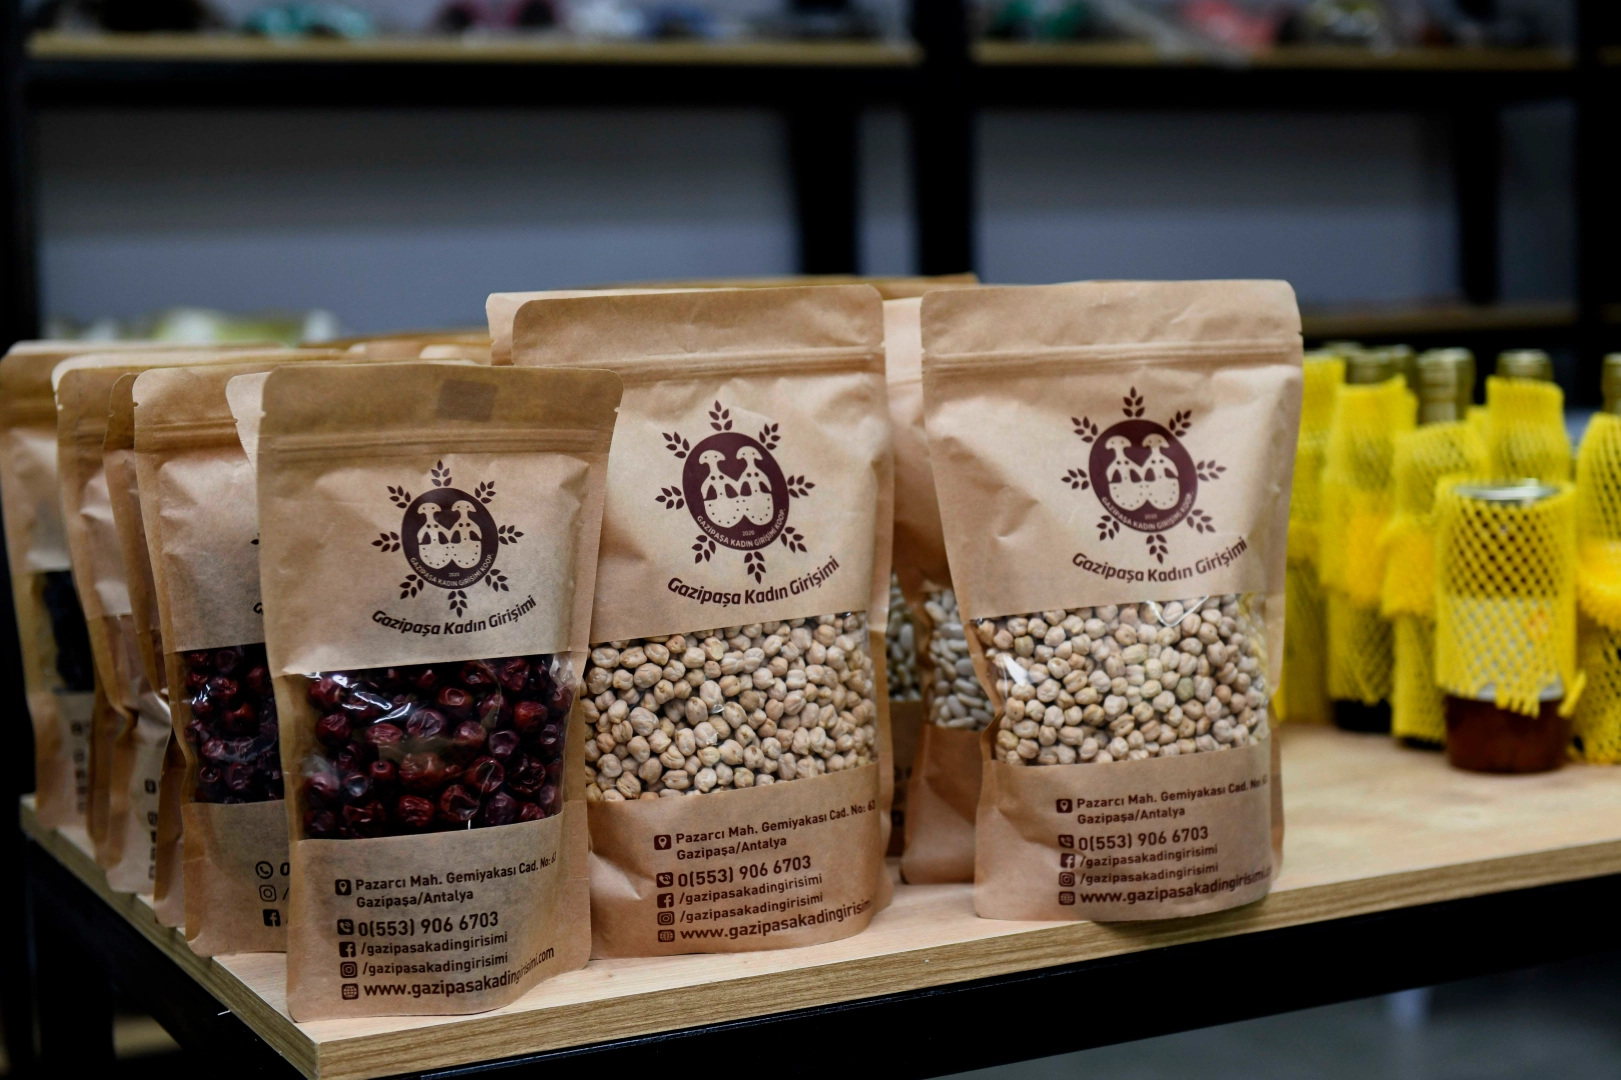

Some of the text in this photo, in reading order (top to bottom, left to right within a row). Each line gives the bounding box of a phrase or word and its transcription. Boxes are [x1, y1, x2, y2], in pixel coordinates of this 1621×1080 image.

[731, 539, 754, 548] KADIN
[1072, 536, 1248, 583] Gazipaşa Kadın Girişimi
[668, 555, 840, 608] Gazipaşa Kadın Girişimi
[372, 594, 537, 636] Gazipaşa Kadın Girişimi
[1077, 798, 1124, 809] Pazarcı
[1128, 794, 1157, 805] Mah.
[1160, 787, 1225, 802] Gemiyakası
[1228, 781, 1248, 793] Cad.
[676, 830, 725, 844] Pazarcı
[729, 825, 758, 838] Mah.
[762, 814, 827, 832] Gemiyakası
[830, 807, 849, 820] Cad.
[850, 804, 866, 815] No:
[1078, 806, 1185, 825] Gazipaşa/Antalya
[677, 837, 787, 860] Gazipaşa/Antalya
[1078, 826, 1209, 852] 0(553) 906 6703
[1080, 844, 1218, 868] /gazipasakadingirisimi
[356, 879, 406, 890] Pazarcı
[410, 875, 442, 887] Mah.
[446, 867, 516, 884] Gemiyakası
[519, 860, 538, 874] Cad.
[678, 855, 812, 887] 0(553) 906 6703
[1080, 862, 1218, 885] /gazipasakadingirisimi
[357, 890, 474, 908] Gazipaşa/Antalya
[679, 874, 822, 905] /gazipasakadingirisimi
[680, 892, 823, 924] /gazipasakadingirisimi
[358, 911, 498, 937] 0(553) 906 6703
[361, 931, 508, 956] /gazipasakadingirisimi
[363, 952, 508, 976] /gazipasakadingirisimi
[364, 947, 554, 998] www.gazipasakadingirisimi.com
